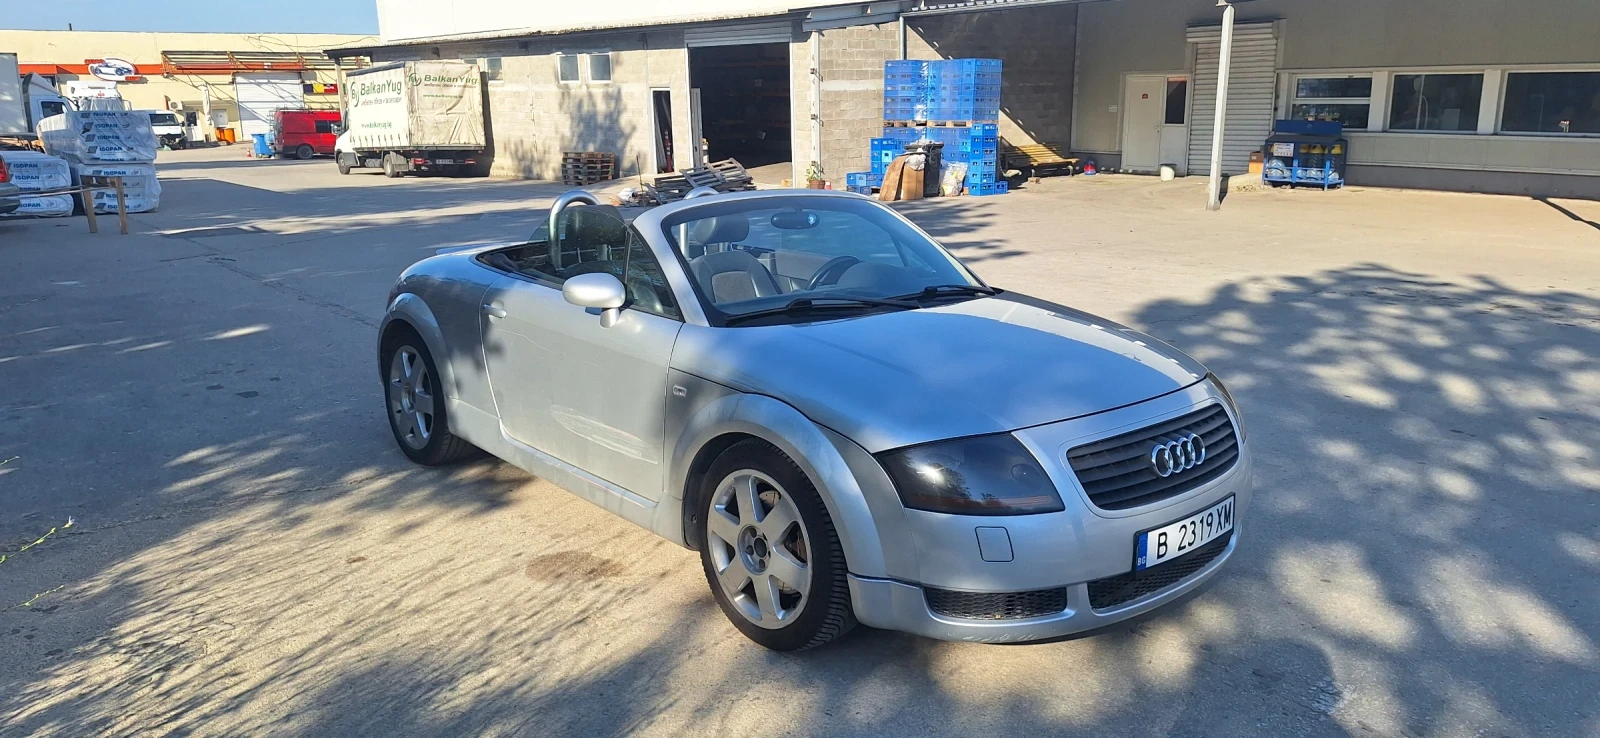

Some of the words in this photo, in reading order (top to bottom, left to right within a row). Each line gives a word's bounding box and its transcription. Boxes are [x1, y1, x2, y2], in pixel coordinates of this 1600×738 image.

[424, 75, 478, 84] BalkanYug
[360, 80, 402, 96] BalkanYug
[1157, 532, 1168, 560] B
[1178, 512, 1213, 551] 2319
[1216, 502, 1231, 533] XM
[1137, 556, 1146, 566] BG
